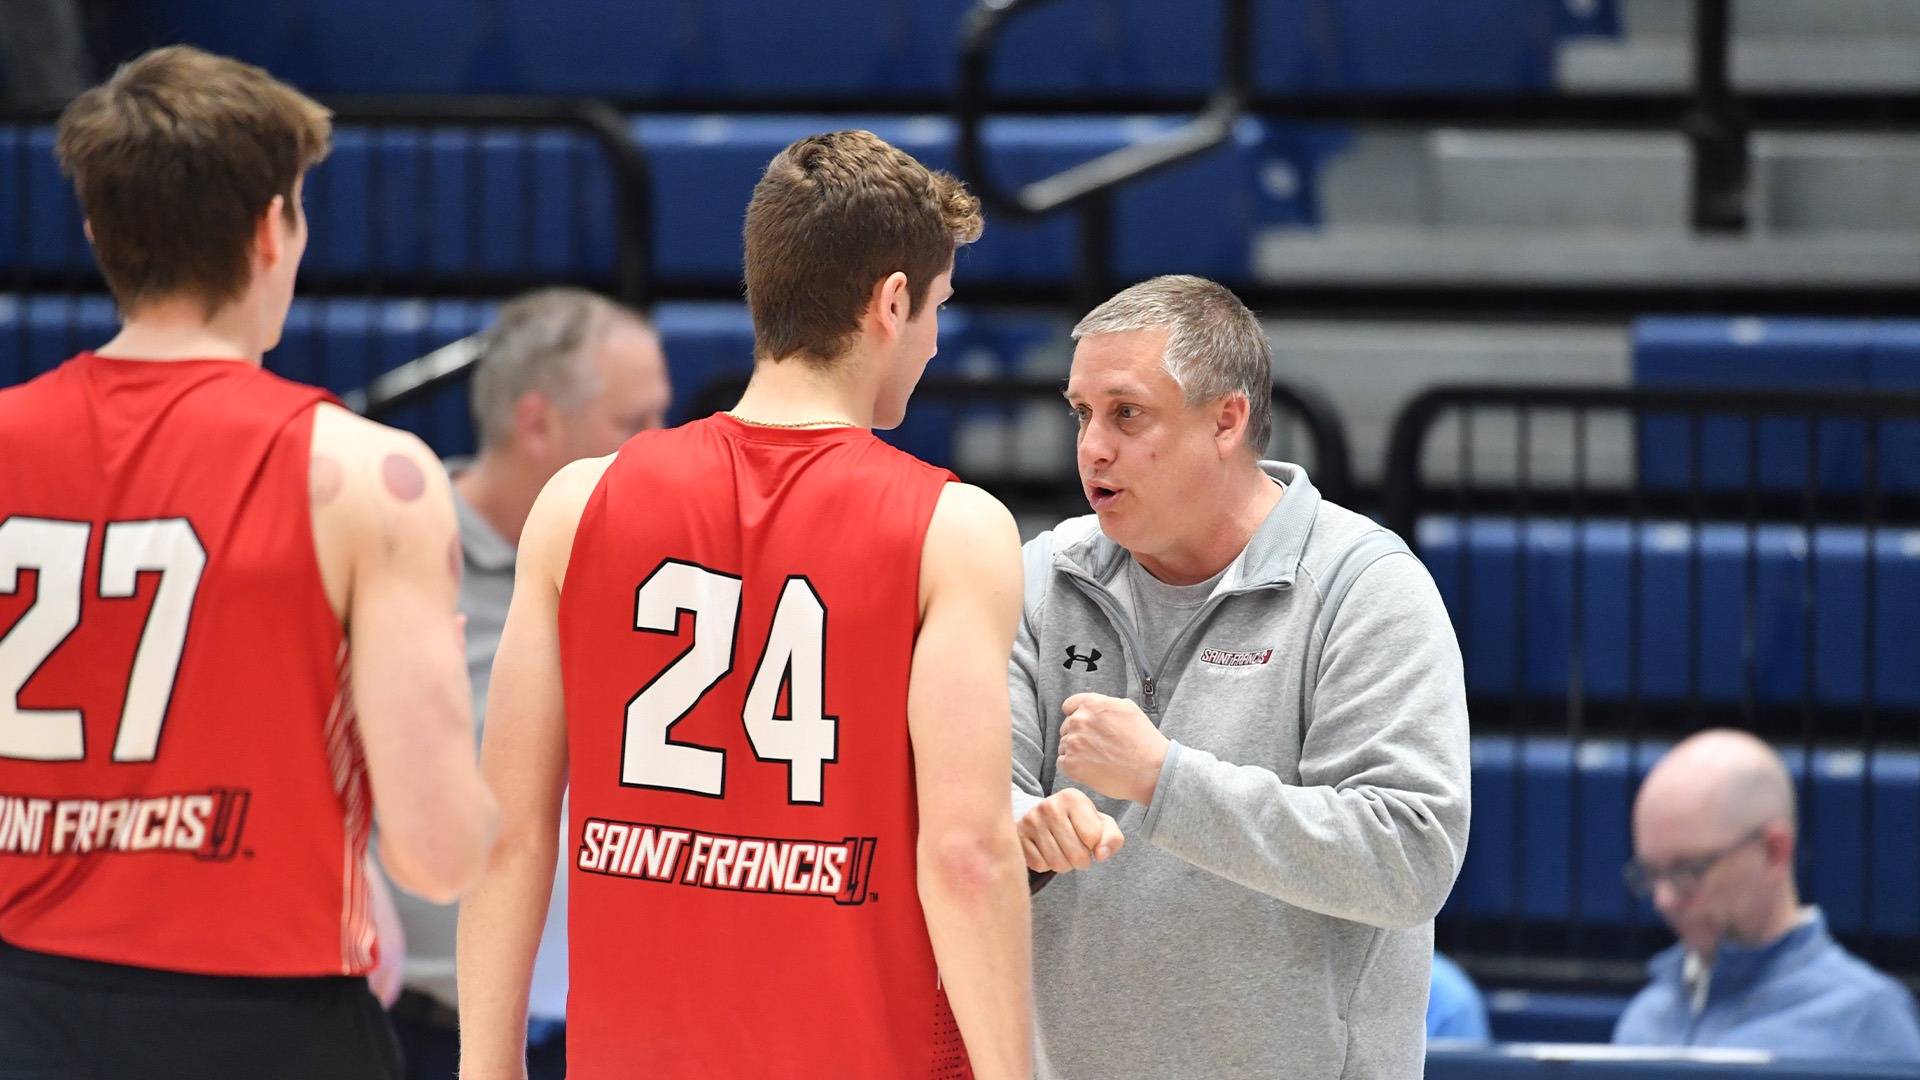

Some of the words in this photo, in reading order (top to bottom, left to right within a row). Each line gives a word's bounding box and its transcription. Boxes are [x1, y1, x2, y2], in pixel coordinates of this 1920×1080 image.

[0, 515, 208, 763] 27
[1201, 648, 1232, 665] SAINT
[619, 556, 839, 806] 24
[0, 795, 51, 854] INT
[578, 818, 692, 881] SAINT
